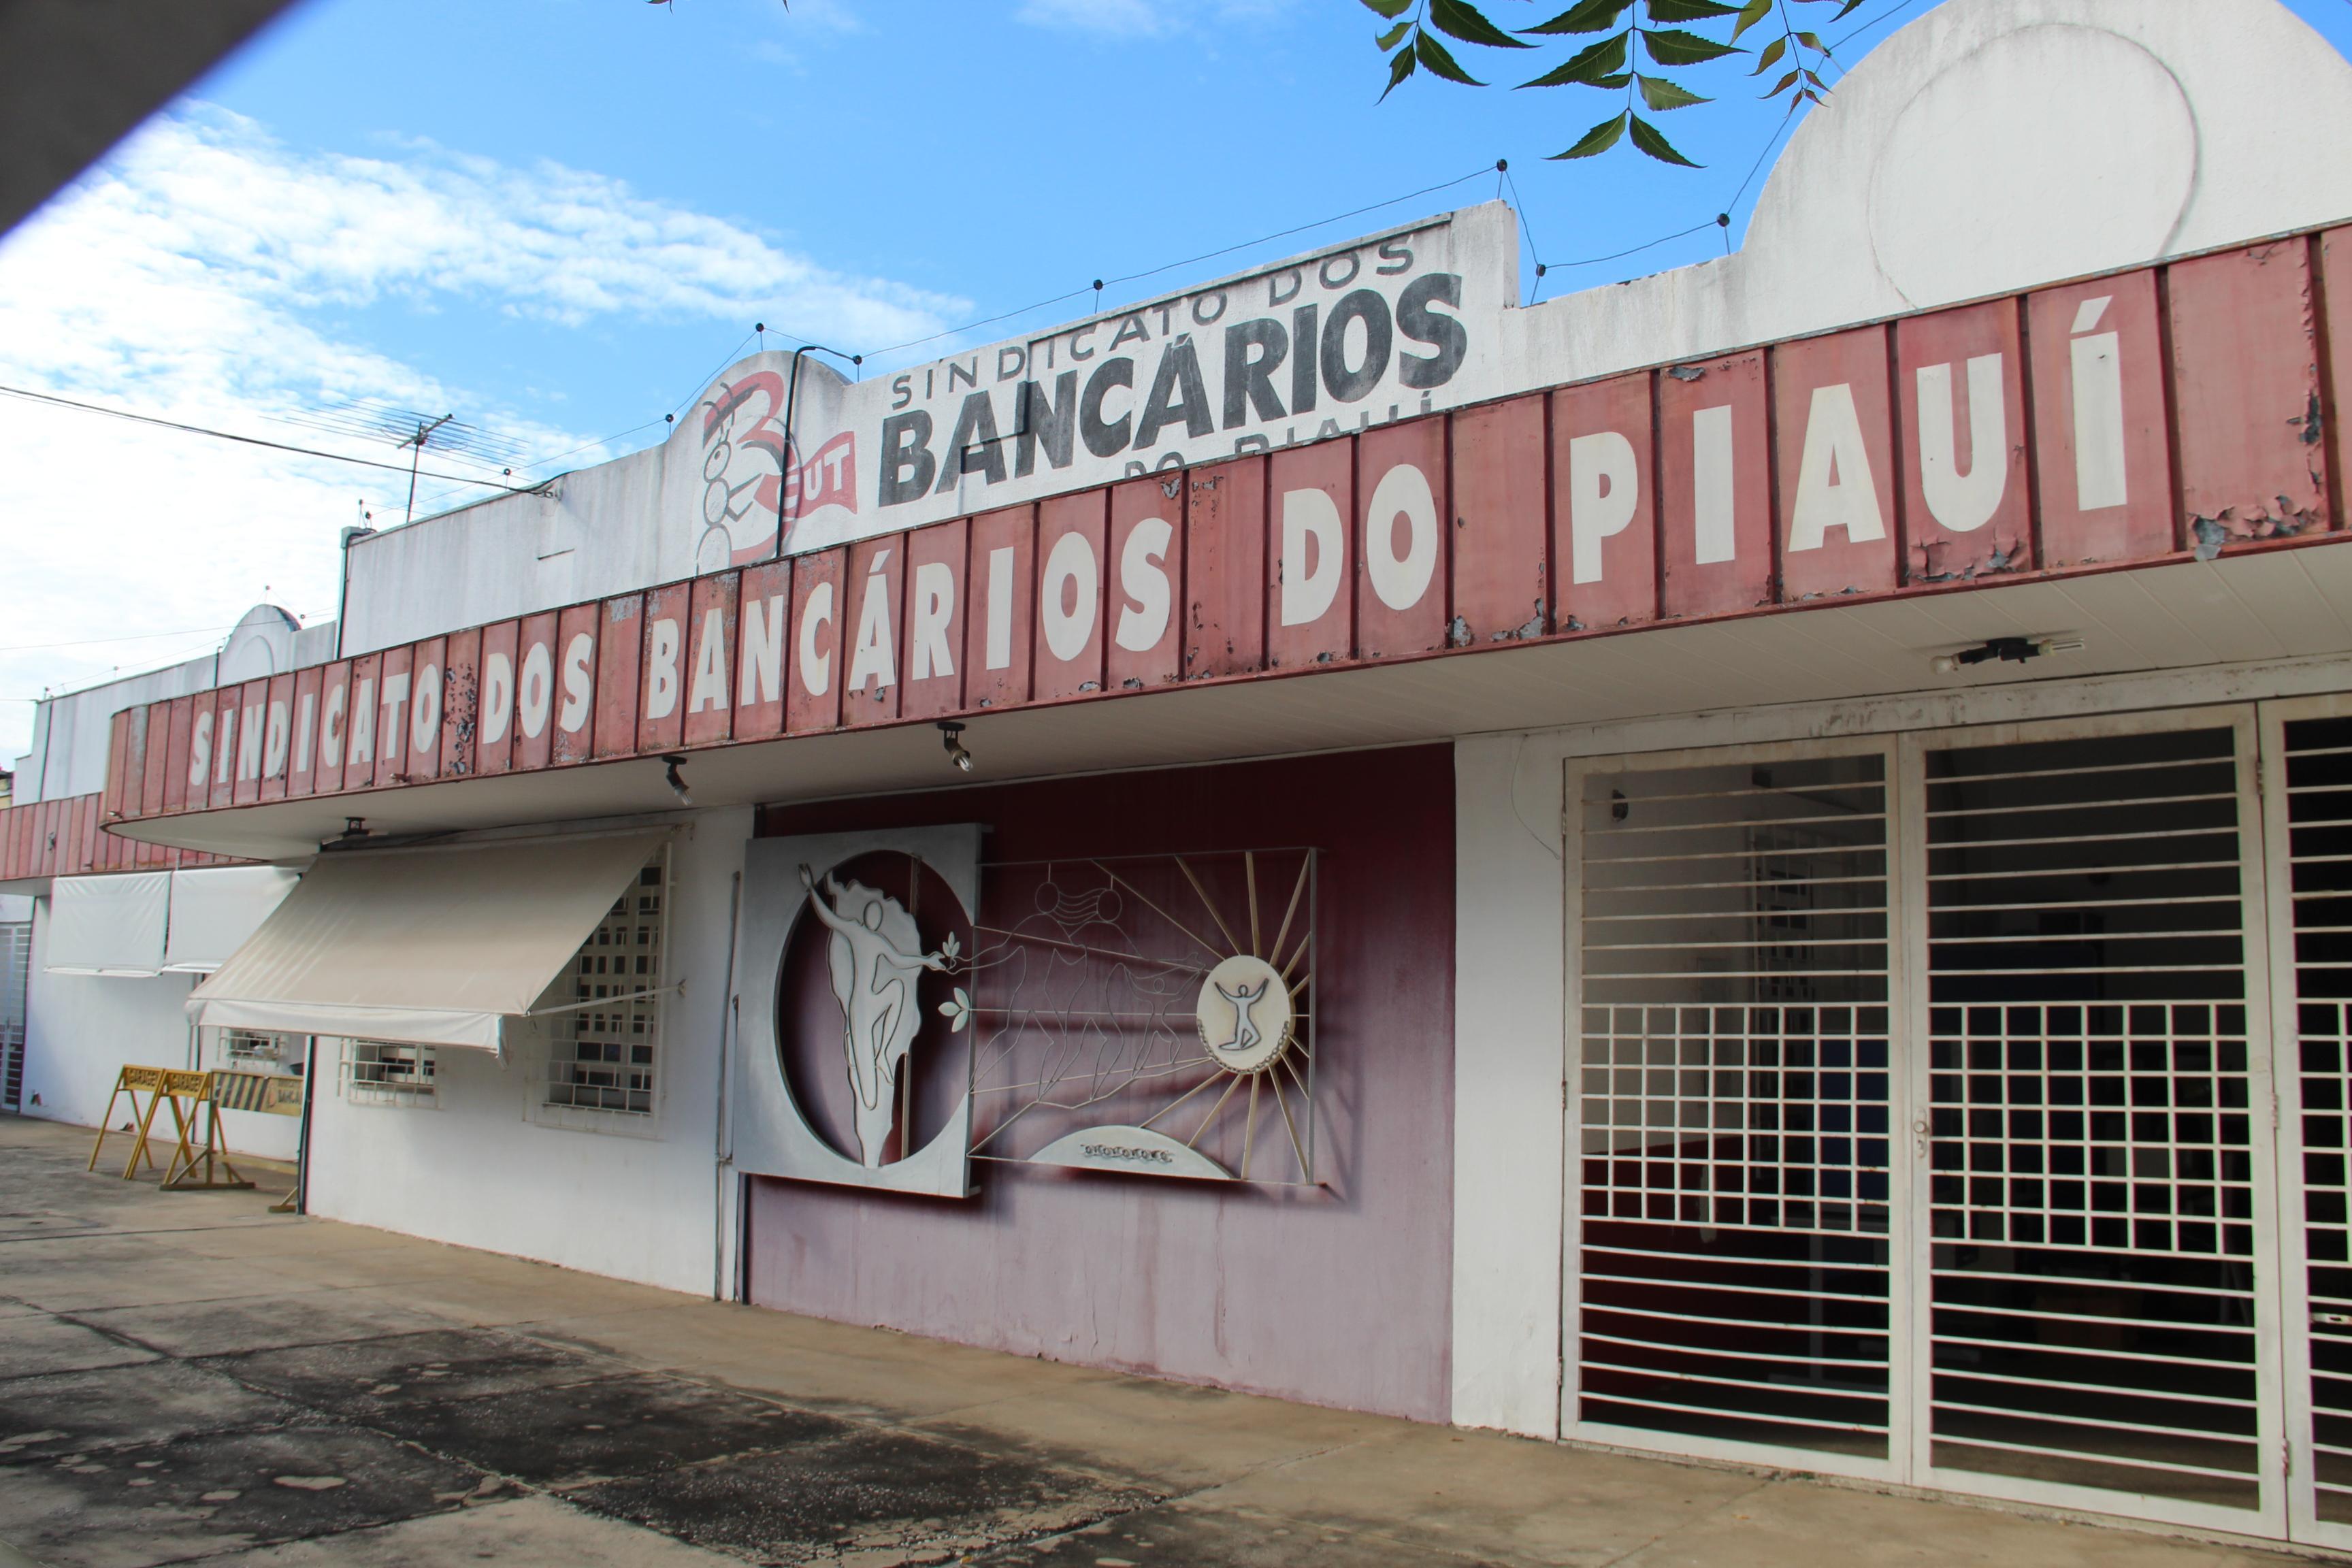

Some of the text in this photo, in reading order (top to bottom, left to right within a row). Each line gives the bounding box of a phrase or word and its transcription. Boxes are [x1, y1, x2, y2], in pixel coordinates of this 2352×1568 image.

[879, 273, 1467, 507] BANCÁRIOS
[893, 237, 1414, 410] SINDICATO DOS
[191, 295, 2128, 786] SINDICATO DOS BANCÁRIOS DO PIAUÍ
[777, 442, 850, 510] CUT
